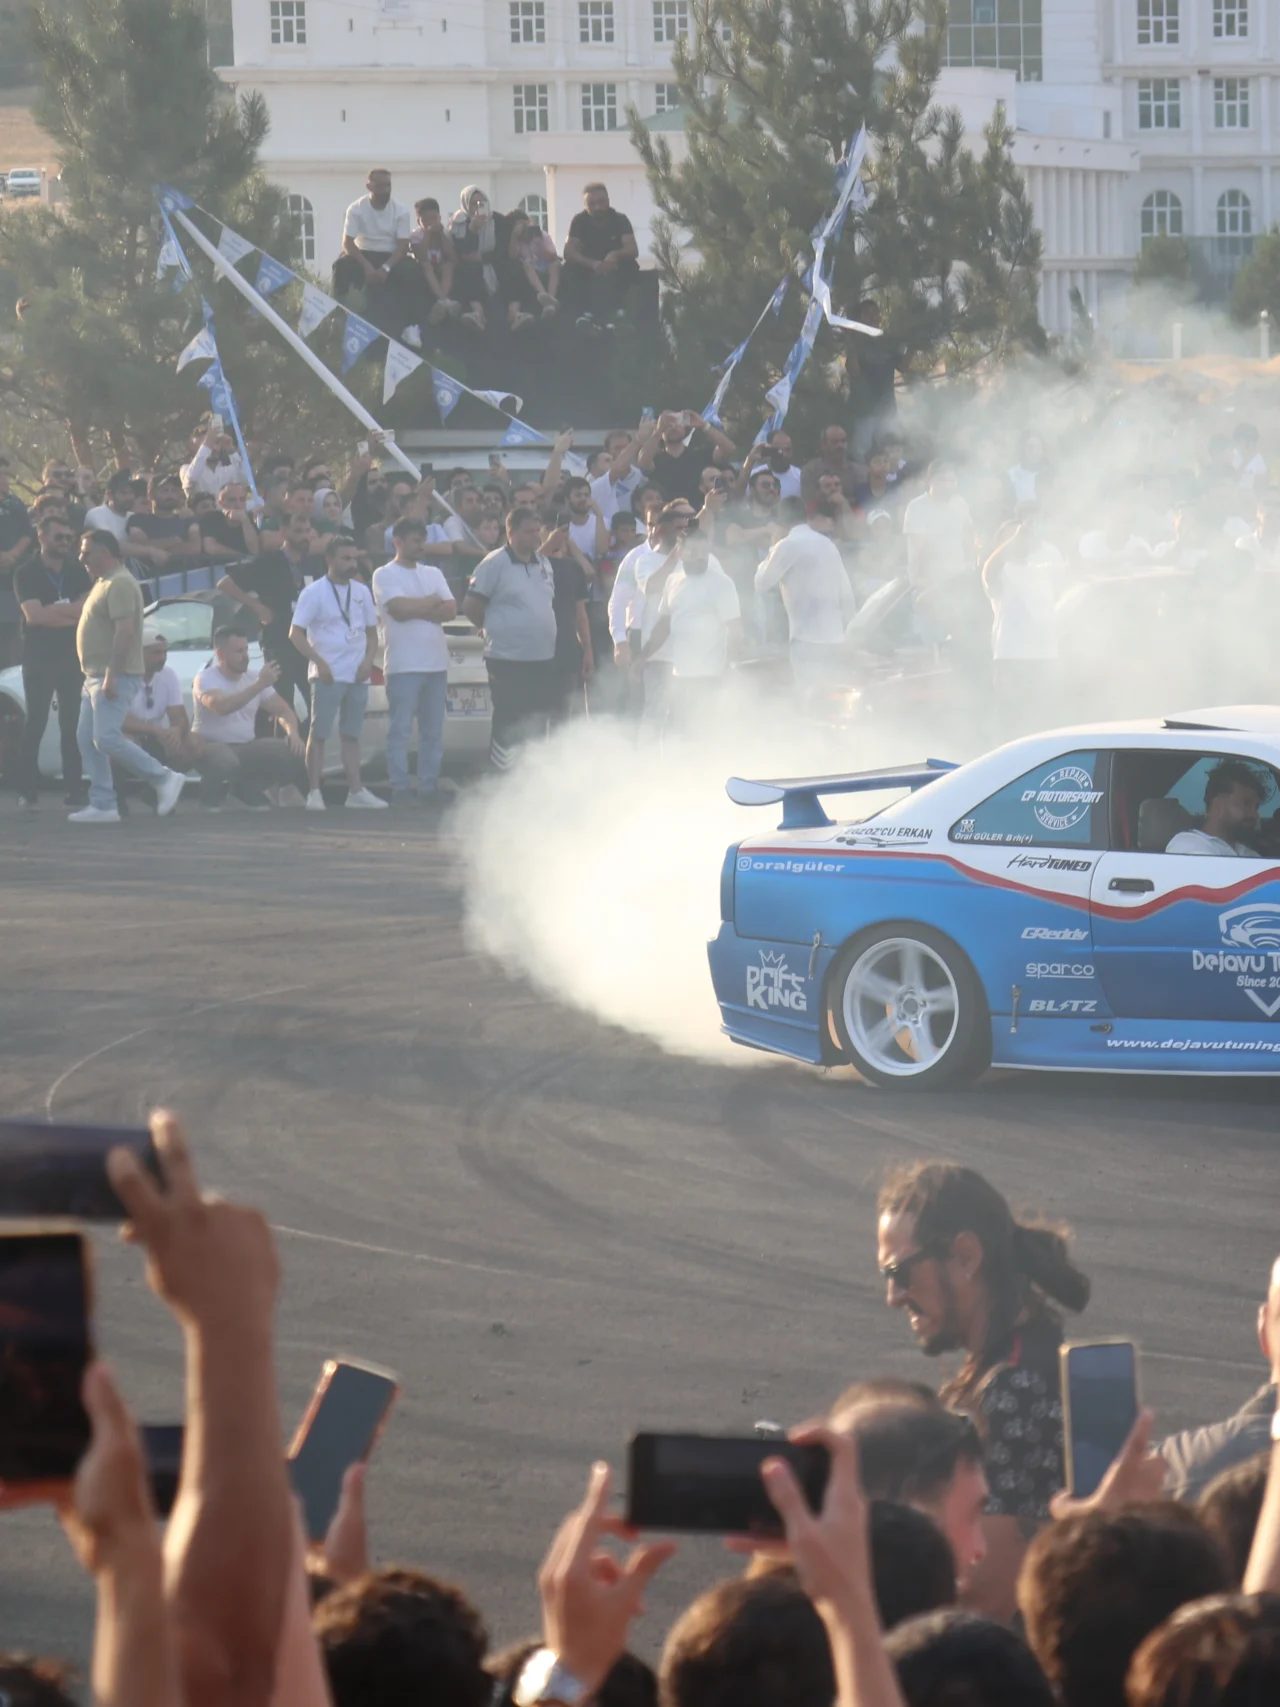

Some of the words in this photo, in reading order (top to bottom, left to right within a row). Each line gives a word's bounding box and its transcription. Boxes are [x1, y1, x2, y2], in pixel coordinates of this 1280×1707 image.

[1059, 769, 1086, 783] REPAIR
[1021, 790, 1036, 801] CP
[1036, 790, 1104, 803] MOTORSPORT
[1040, 811, 1069, 828] SERVICE
[897, 827, 933, 839] ERKAN
[954, 832, 972, 841] Oral
[974, 832, 1003, 841] GÜLER
[753, 860, 845, 873] oralgüler
[1021, 927, 1089, 940] GReddy
[1192, 949, 1265, 974] Dejavu
[1025, 962, 1095, 979] sparco
[1236, 975, 1266, 987] Since
[747, 984, 807, 1011] KING
[1029, 999, 1097, 1012] BLITZ
